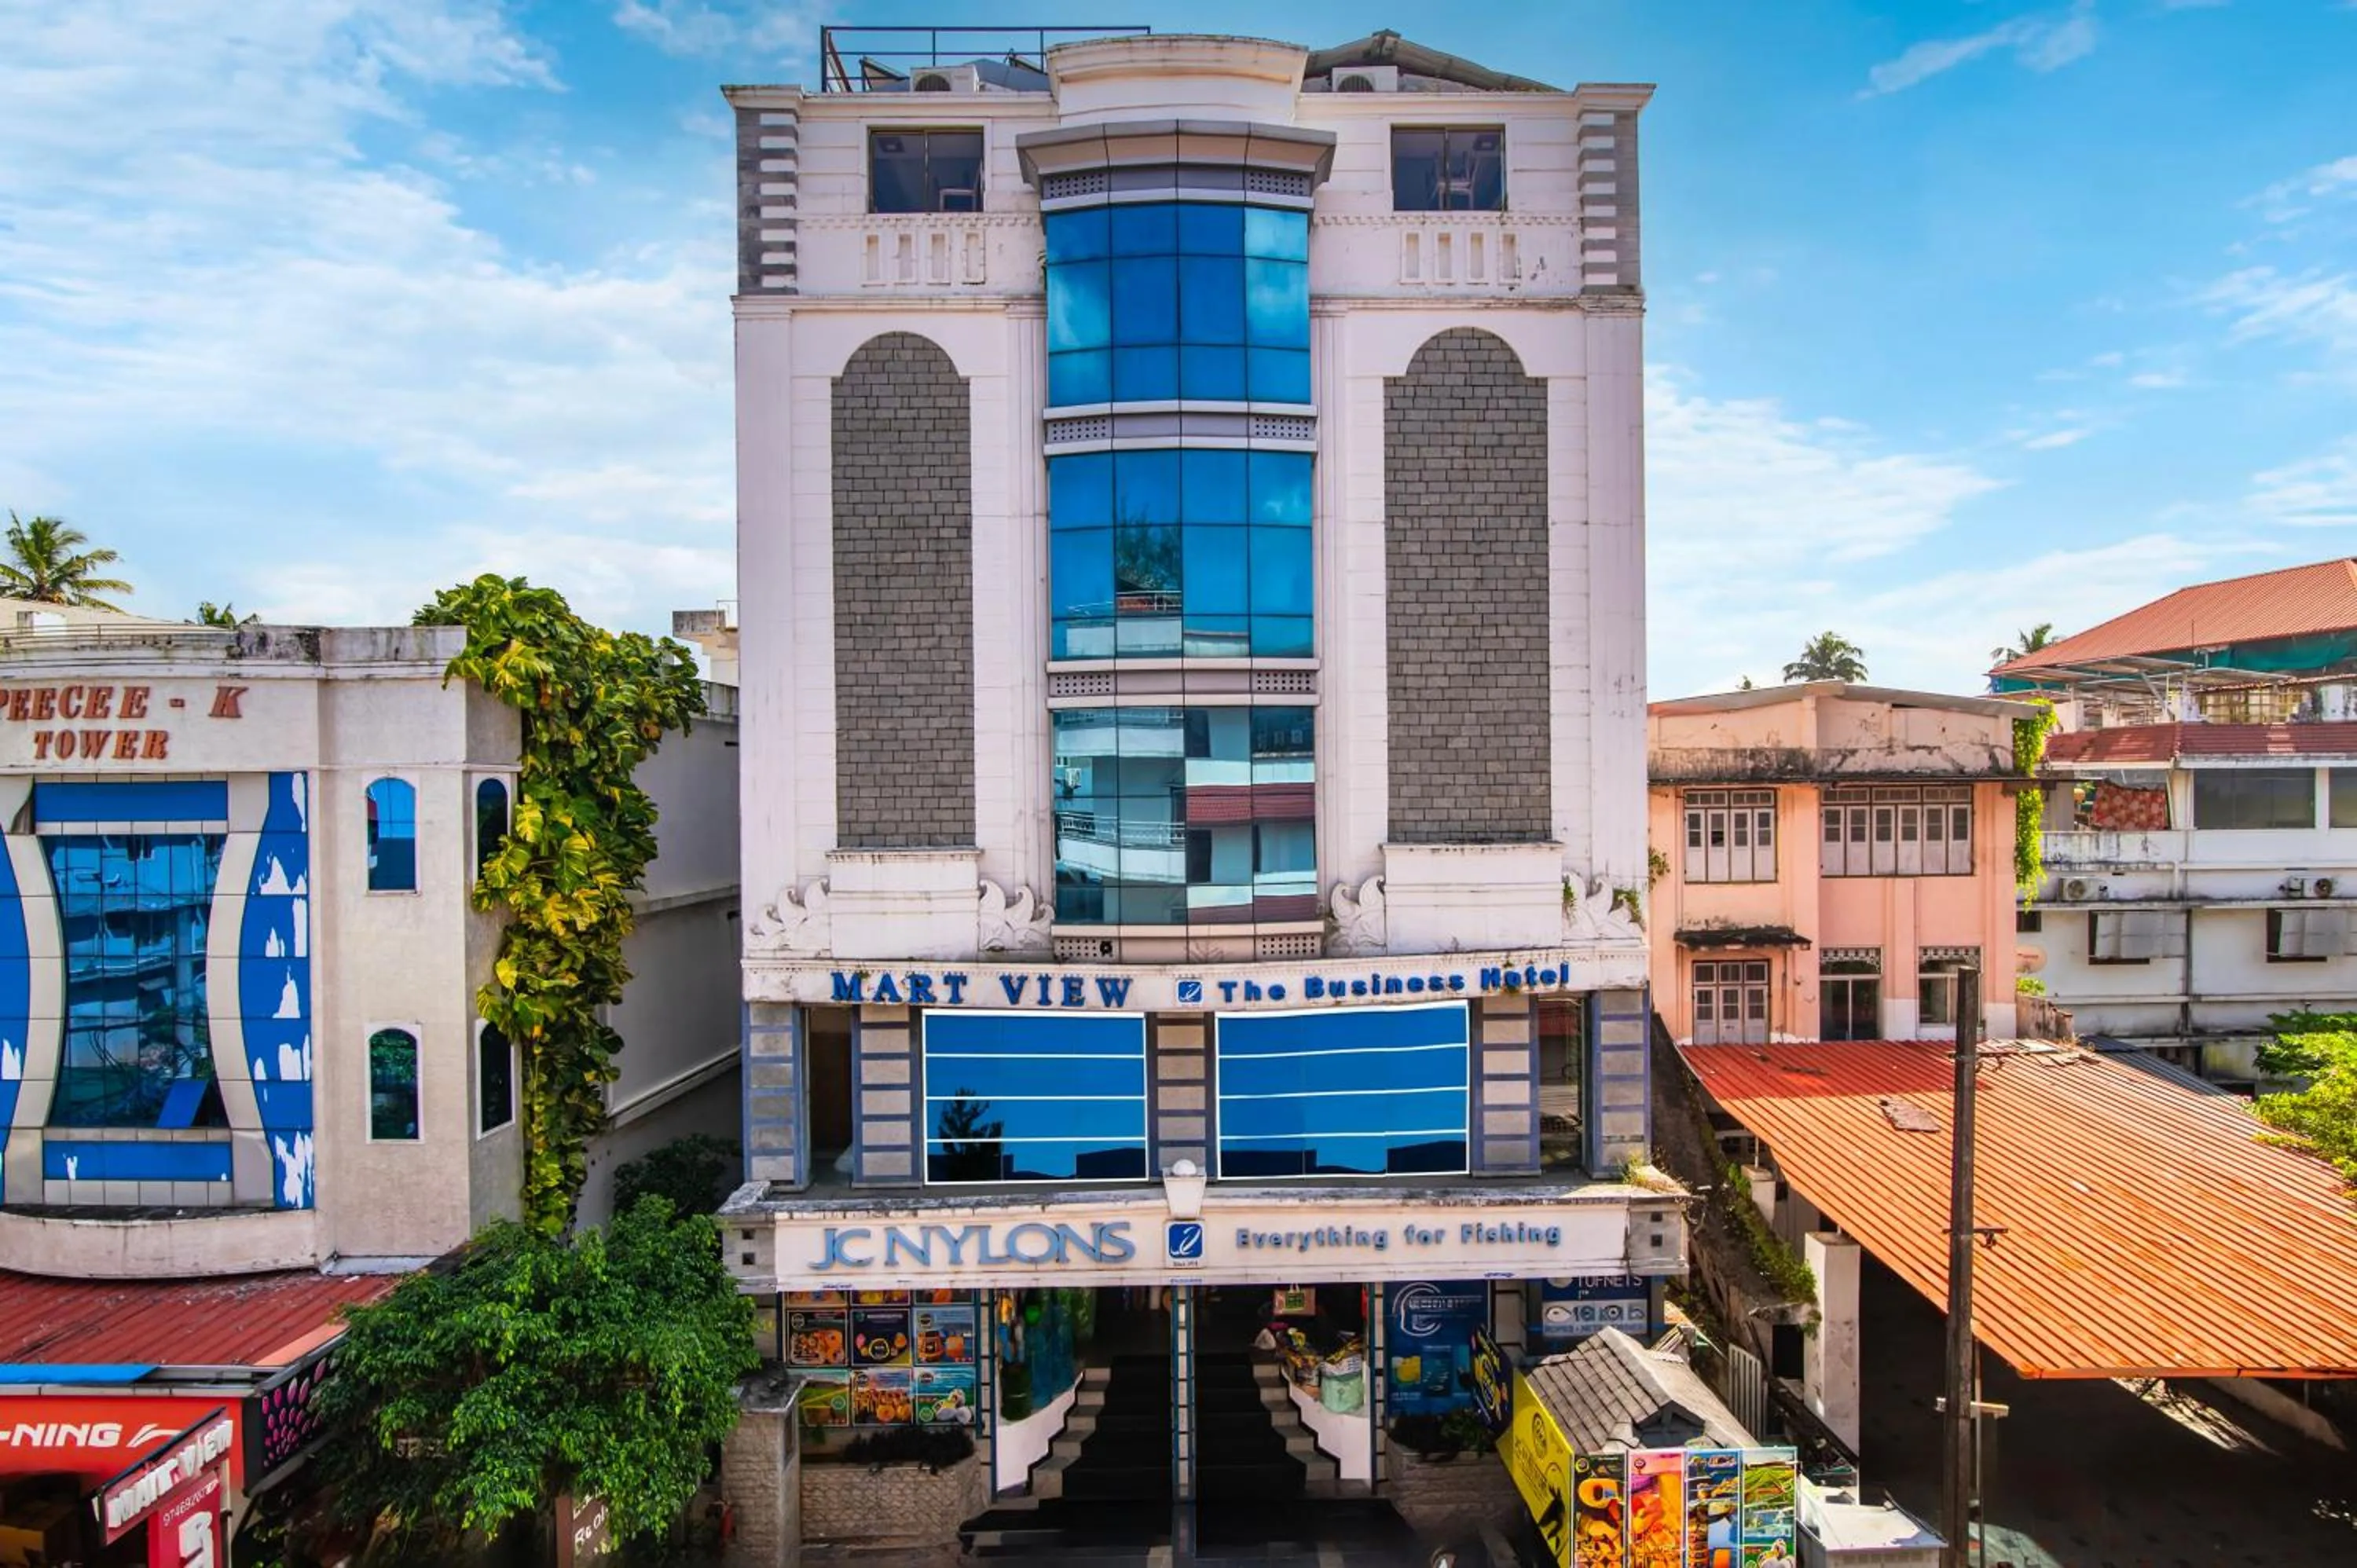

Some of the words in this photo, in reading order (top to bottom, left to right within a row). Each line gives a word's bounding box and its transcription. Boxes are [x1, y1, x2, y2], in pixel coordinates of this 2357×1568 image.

[208, 686, 249, 719] K
[34, 729, 169, 760] TOWER
[830, 970, 968, 1005] MART
[999, 973, 1134, 1008] VIEW
[1218, 980, 1286, 1003] The
[1304, 970, 1465, 1000] Business
[1480, 962, 1570, 991] Hotel
[808, 1227, 875, 1271] JC
[884, 1222, 1136, 1267] NYLONS
[1235, 1225, 1389, 1252] Everything
[1403, 1223, 1447, 1245] for
[1461, 1222, 1562, 1247] Fishing
